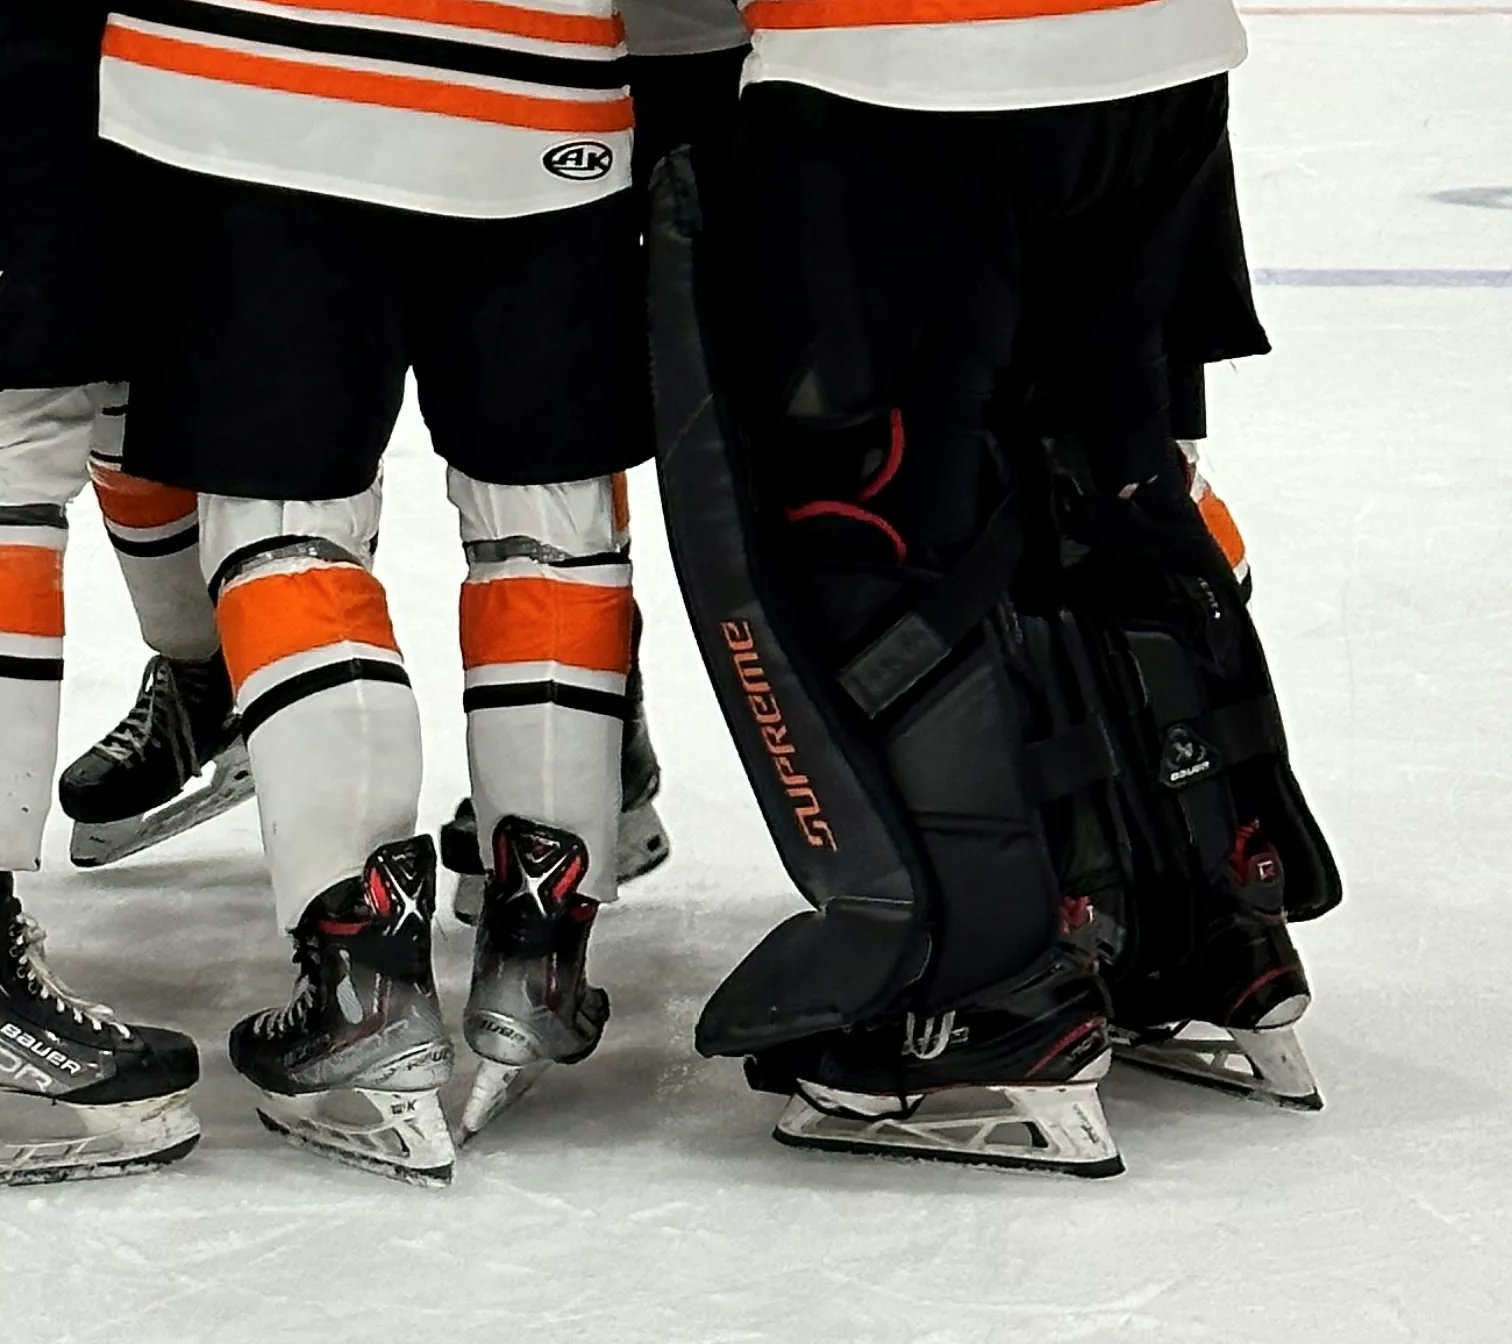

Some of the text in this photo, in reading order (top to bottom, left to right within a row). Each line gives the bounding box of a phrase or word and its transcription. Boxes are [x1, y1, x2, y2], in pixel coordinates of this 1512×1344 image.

[549, 141, 613, 179] AK
[719, 619, 838, 853] SUPREME
[0, 1022, 83, 1076] BAUER
